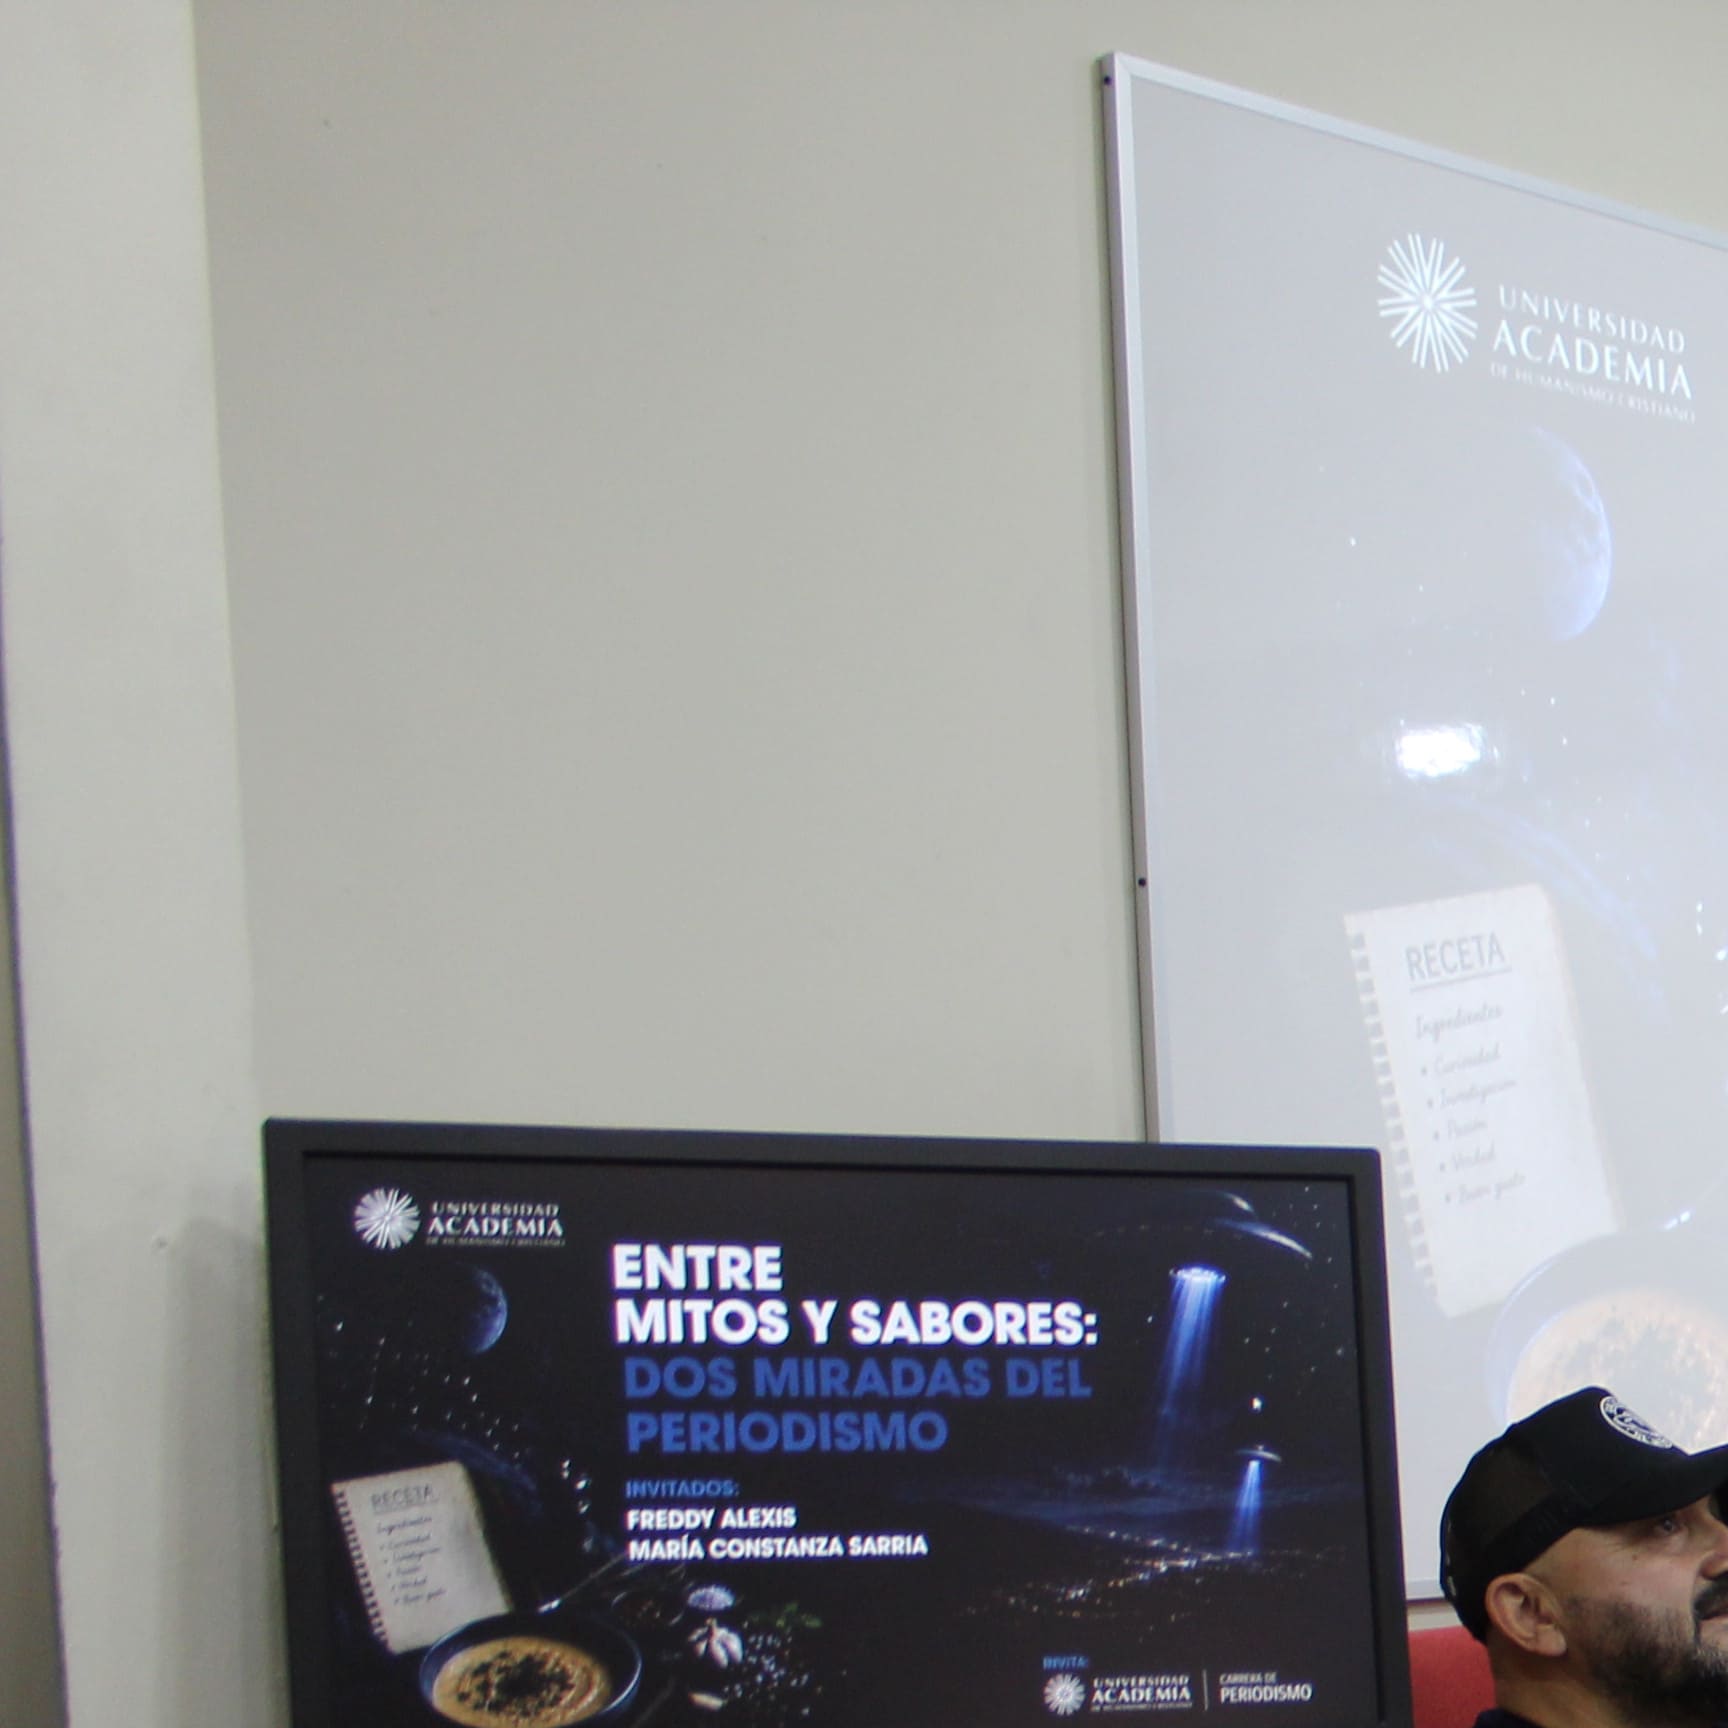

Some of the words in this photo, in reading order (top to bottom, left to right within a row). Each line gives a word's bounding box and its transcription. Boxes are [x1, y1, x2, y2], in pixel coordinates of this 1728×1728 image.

[1497, 284, 1687, 353] UNIVERSIDAD
[1490, 361, 1509, 381] DE
[1491, 318, 1694, 400] ACADEMIA
[1405, 931, 1506, 981] RECETA
[431, 1202, 560, 1217] UNIVERSIDAD
[428, 1217, 564, 1236] ACADEMIA
[614, 1244, 783, 1291] ENTRE
[615, 1299, 790, 1344] MITOS
[802, 1301, 838, 1344] Y
[850, 1301, 1099, 1346] SABORES:
[624, 1357, 737, 1398] DOS
[753, 1358, 990, 1398] MIRADAS
[1006, 1358, 1093, 1398] DEL
[627, 1411, 949, 1453] PERIODISMO
[625, 1480, 740, 1498] INVITADOS:
[626, 1508, 715, 1531] FREDDY
[720, 1506, 797, 1529] ALEXIS
[629, 1533, 705, 1561] MARÍA
[708, 1536, 844, 1560] CONSTANZA
[848, 1534, 929, 1557] SARRIA
[1091, 1686, 1192, 1704] ACADEMIA
[1220, 1684, 1313, 1704] PERIODISMO
[1092, 1675, 1191, 1689] UNIVERSIDAD
